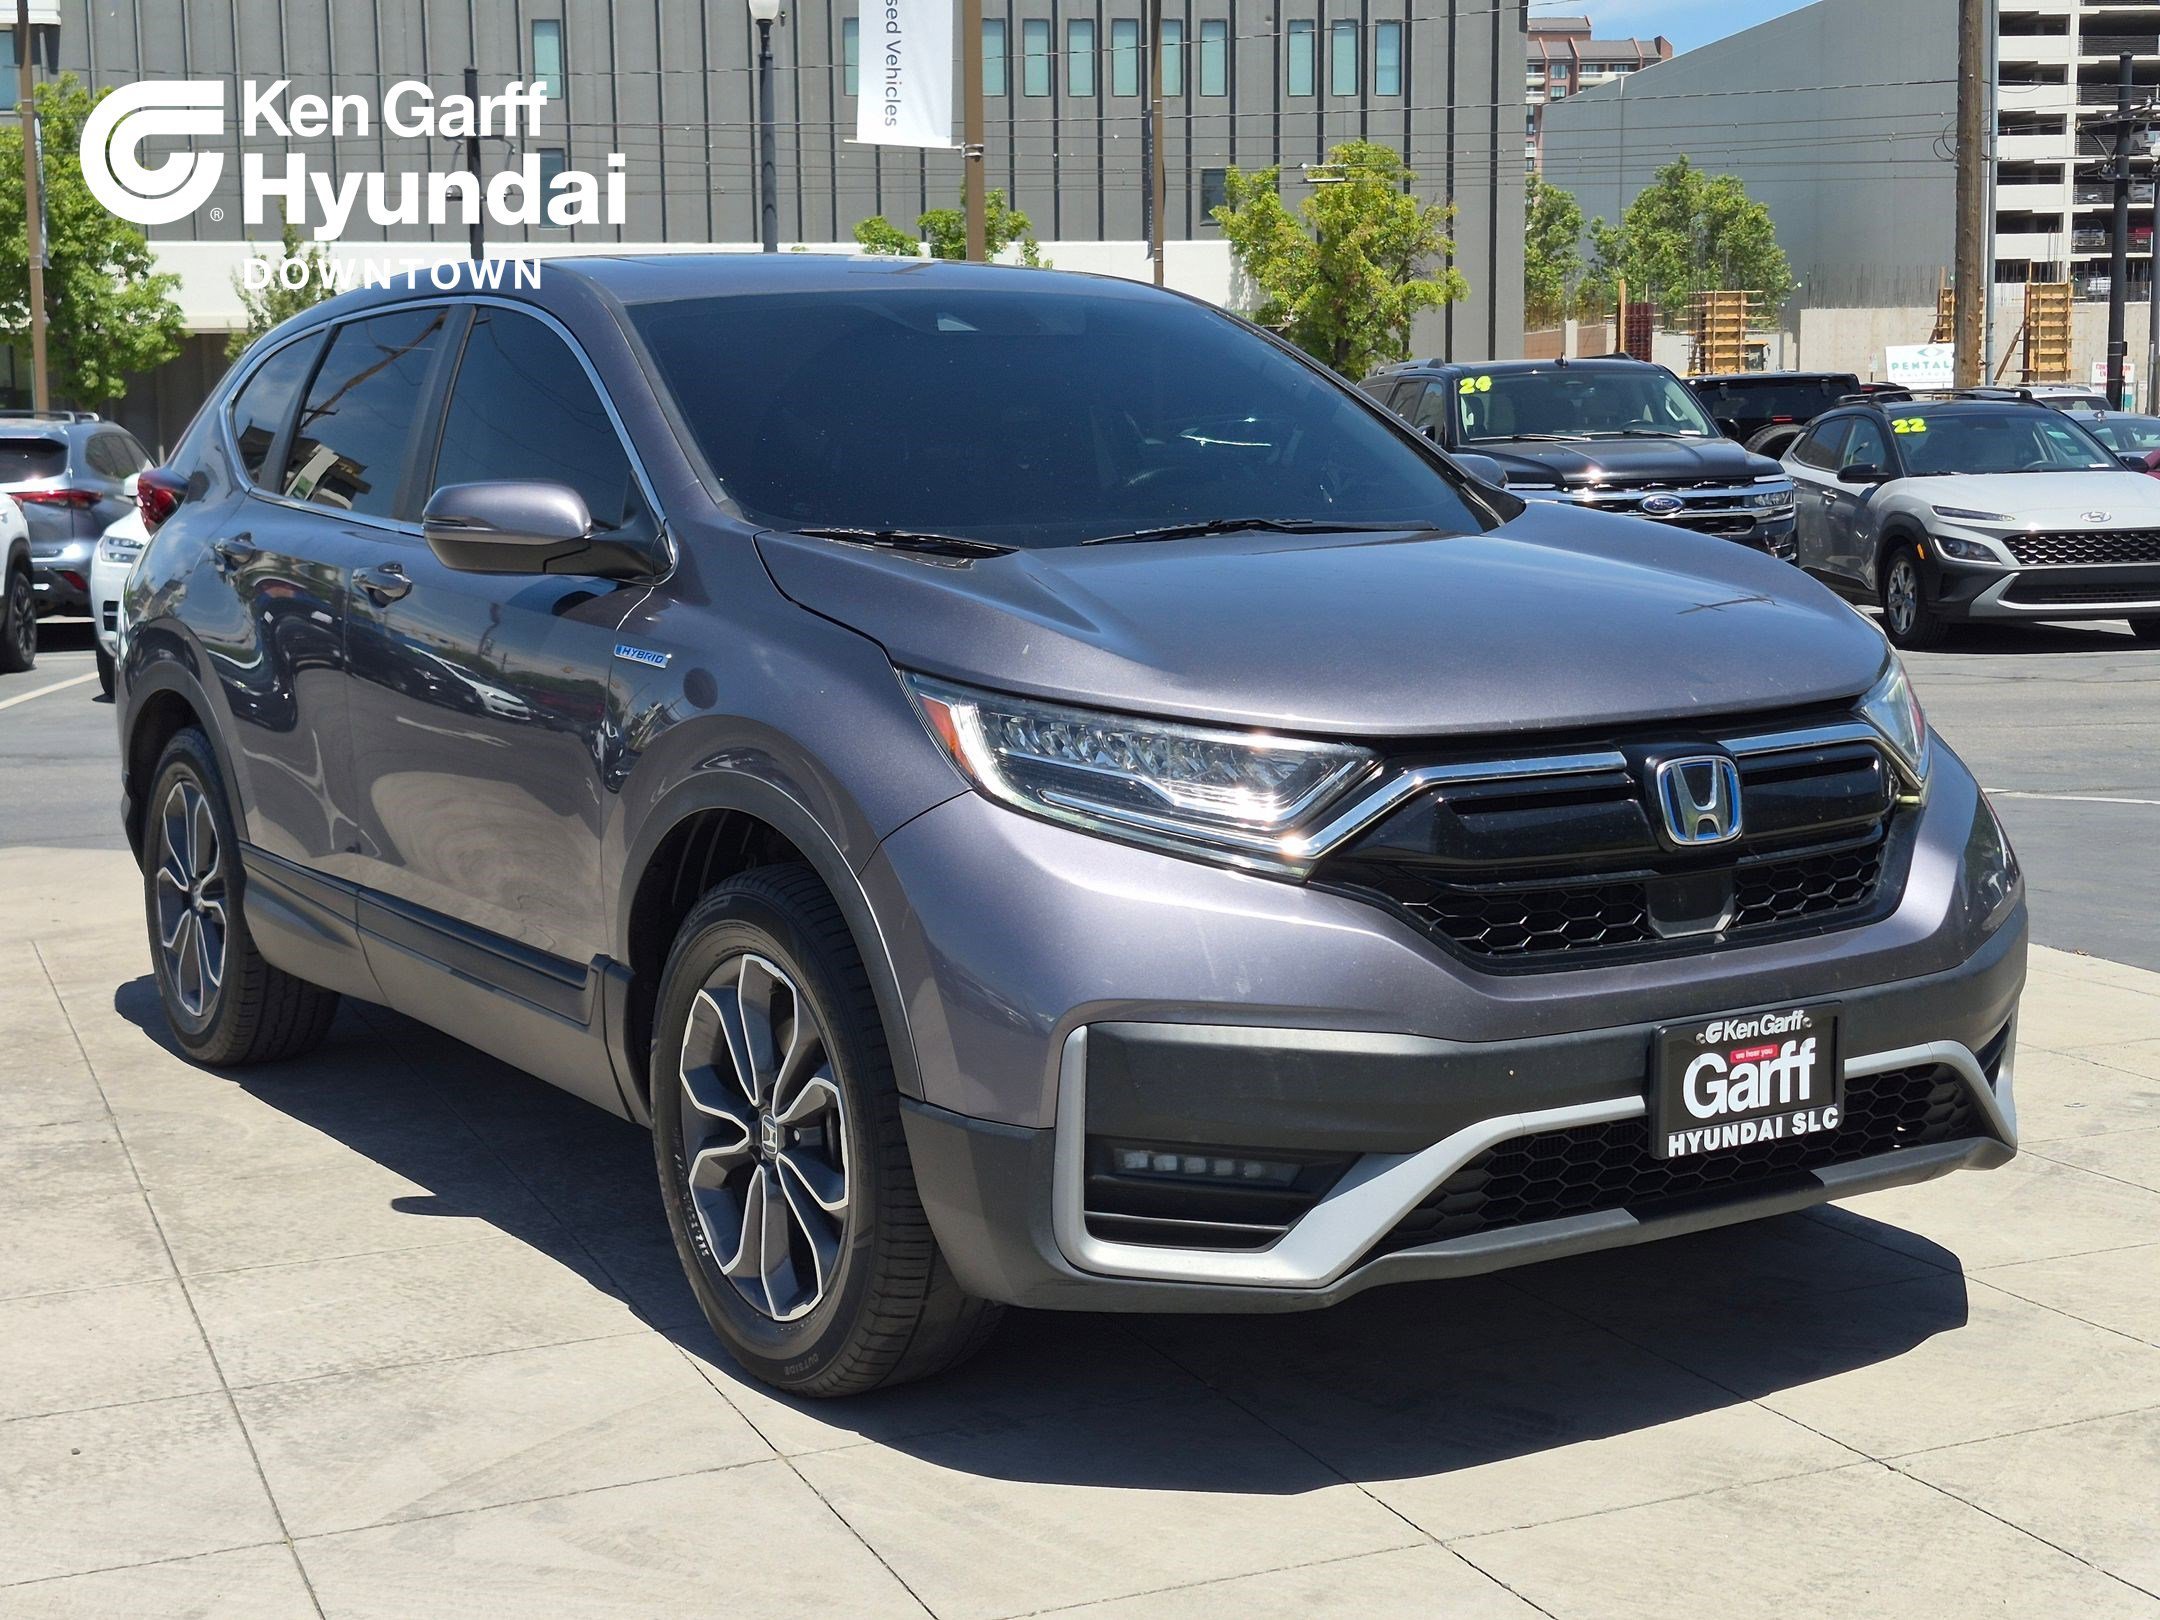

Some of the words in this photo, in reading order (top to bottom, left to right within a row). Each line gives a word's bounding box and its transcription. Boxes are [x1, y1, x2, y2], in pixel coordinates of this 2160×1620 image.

[885, 40, 902, 127] Vehicles
[1459, 375, 1492, 394] 24
[1892, 418, 1927, 433] 22
[621, 646, 665, 664] HYBRID
[1723, 1018, 1760, 1042] Ken
[1760, 1010, 1805, 1035] Garff
[1683, 1037, 1816, 1118] Garff
[1668, 1116, 1783, 1157] HYUNDAI
[1791, 1106, 1839, 1135] SLC
